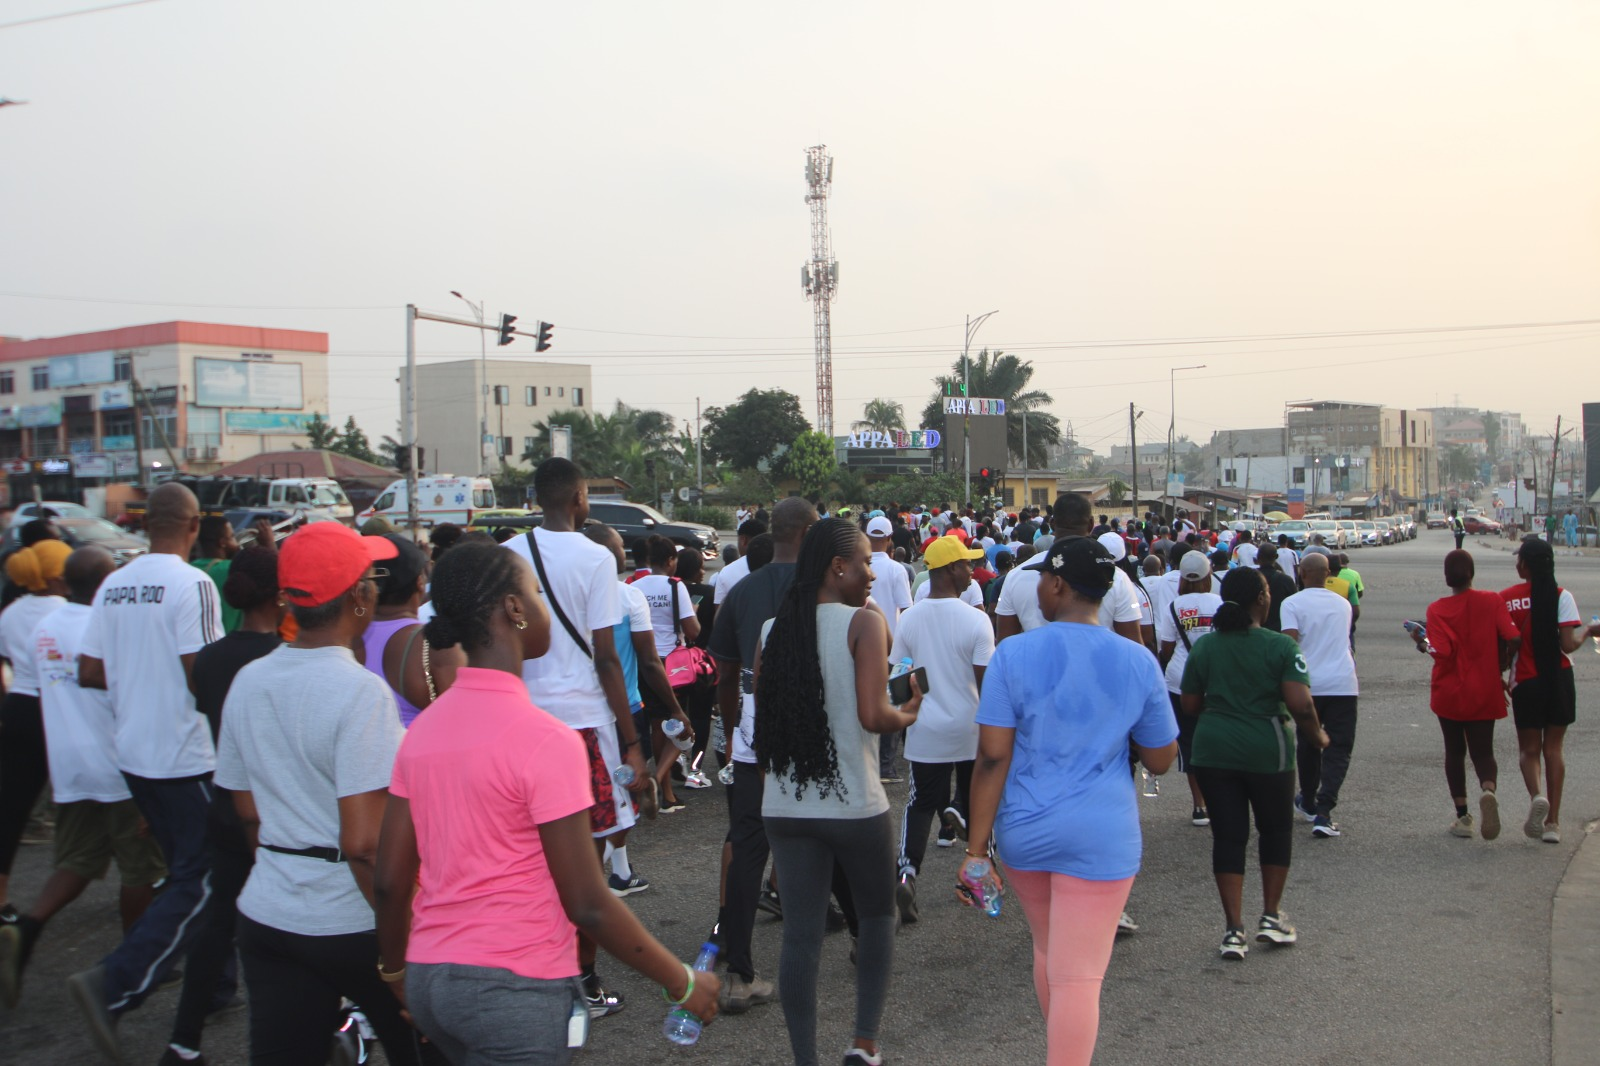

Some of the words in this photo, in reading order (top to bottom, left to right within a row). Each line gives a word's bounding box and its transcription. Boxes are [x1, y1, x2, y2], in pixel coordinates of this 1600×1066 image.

[980, 399, 1005, 415] LED
[842, 429, 896, 449] APPA
[896, 429, 941, 449] LED
[103, 586, 136, 606] PAPA
[1294, 653, 1308, 674] 3
